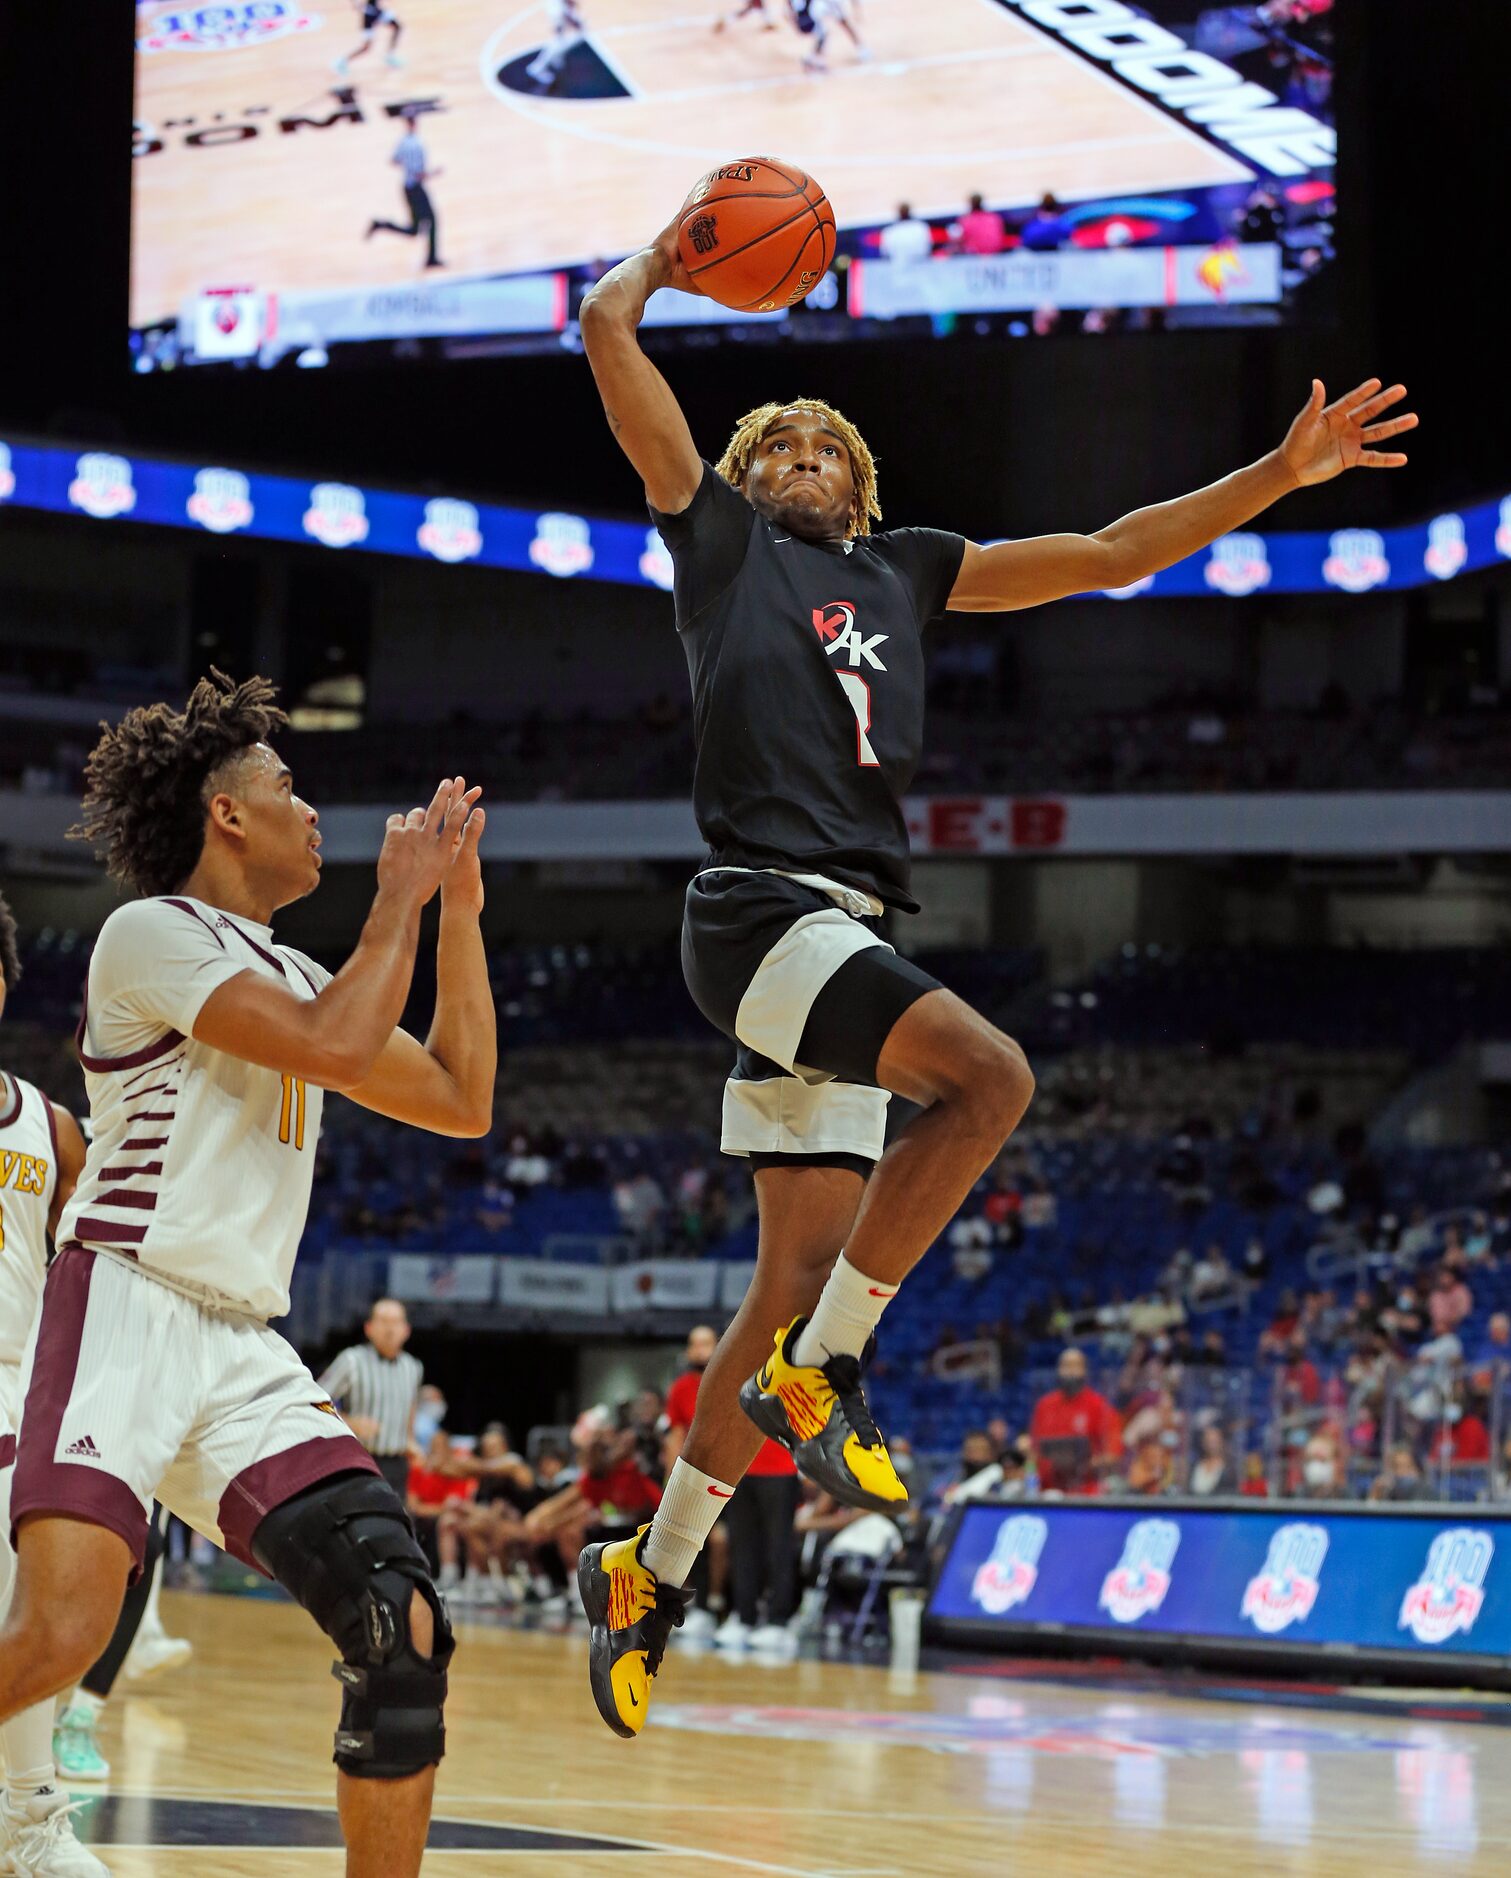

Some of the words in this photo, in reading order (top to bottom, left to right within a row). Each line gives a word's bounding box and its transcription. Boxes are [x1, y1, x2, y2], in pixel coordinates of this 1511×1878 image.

[279, 1072, 306, 1151] 11
[0, 1148, 48, 1196] VES
[65, 1448, 101, 1459] adidas
